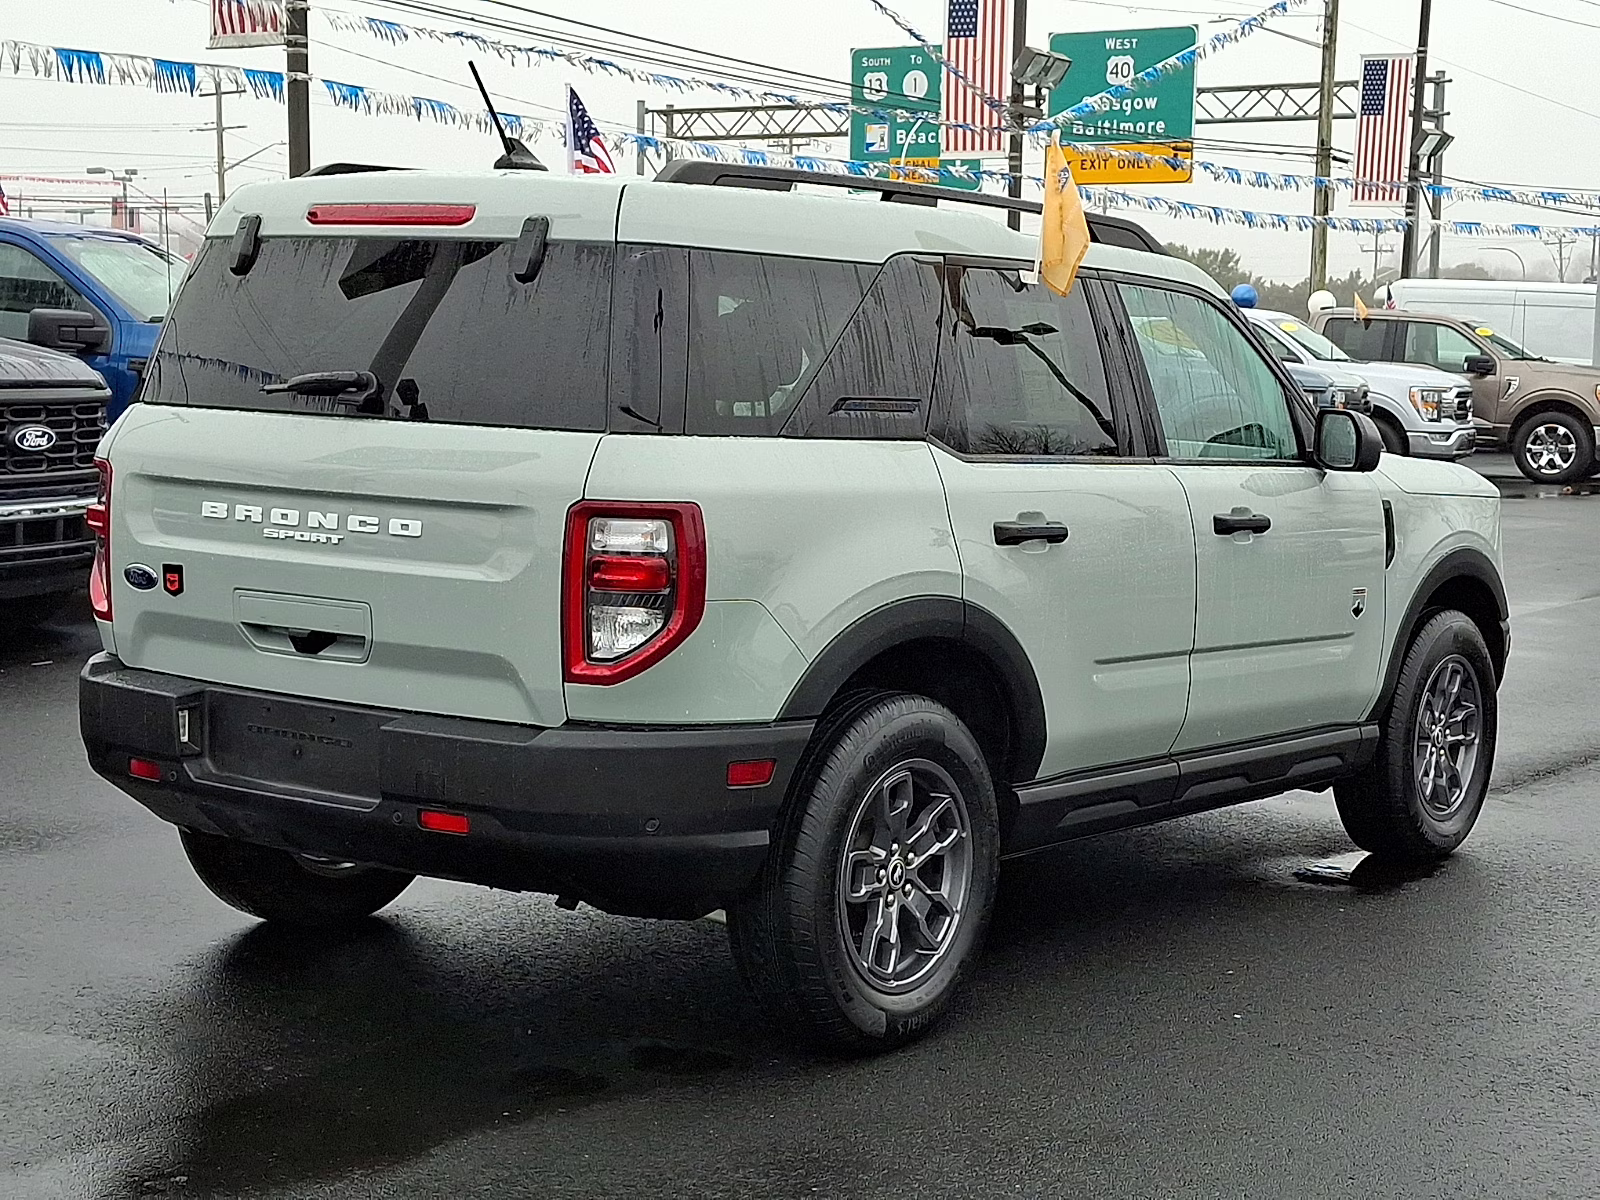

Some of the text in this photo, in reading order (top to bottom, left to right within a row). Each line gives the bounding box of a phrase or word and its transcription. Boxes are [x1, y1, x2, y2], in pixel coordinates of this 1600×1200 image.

[1104, 37, 1139, 50] WEST
[861, 54, 923, 67] SOUTH TO
[1108, 61, 1131, 79] 40
[868, 77, 918, 93] 13 1
[1082, 96, 1158, 116] asgow
[1072, 119, 1166, 136] Baltimore
[896, 129, 941, 145] Beac
[1080, 158, 1152, 170] EXIT ONLY
[23, 430, 49, 447] Ford
[201, 500, 423, 538] BRONCO
[263, 527, 345, 545] SPORT
